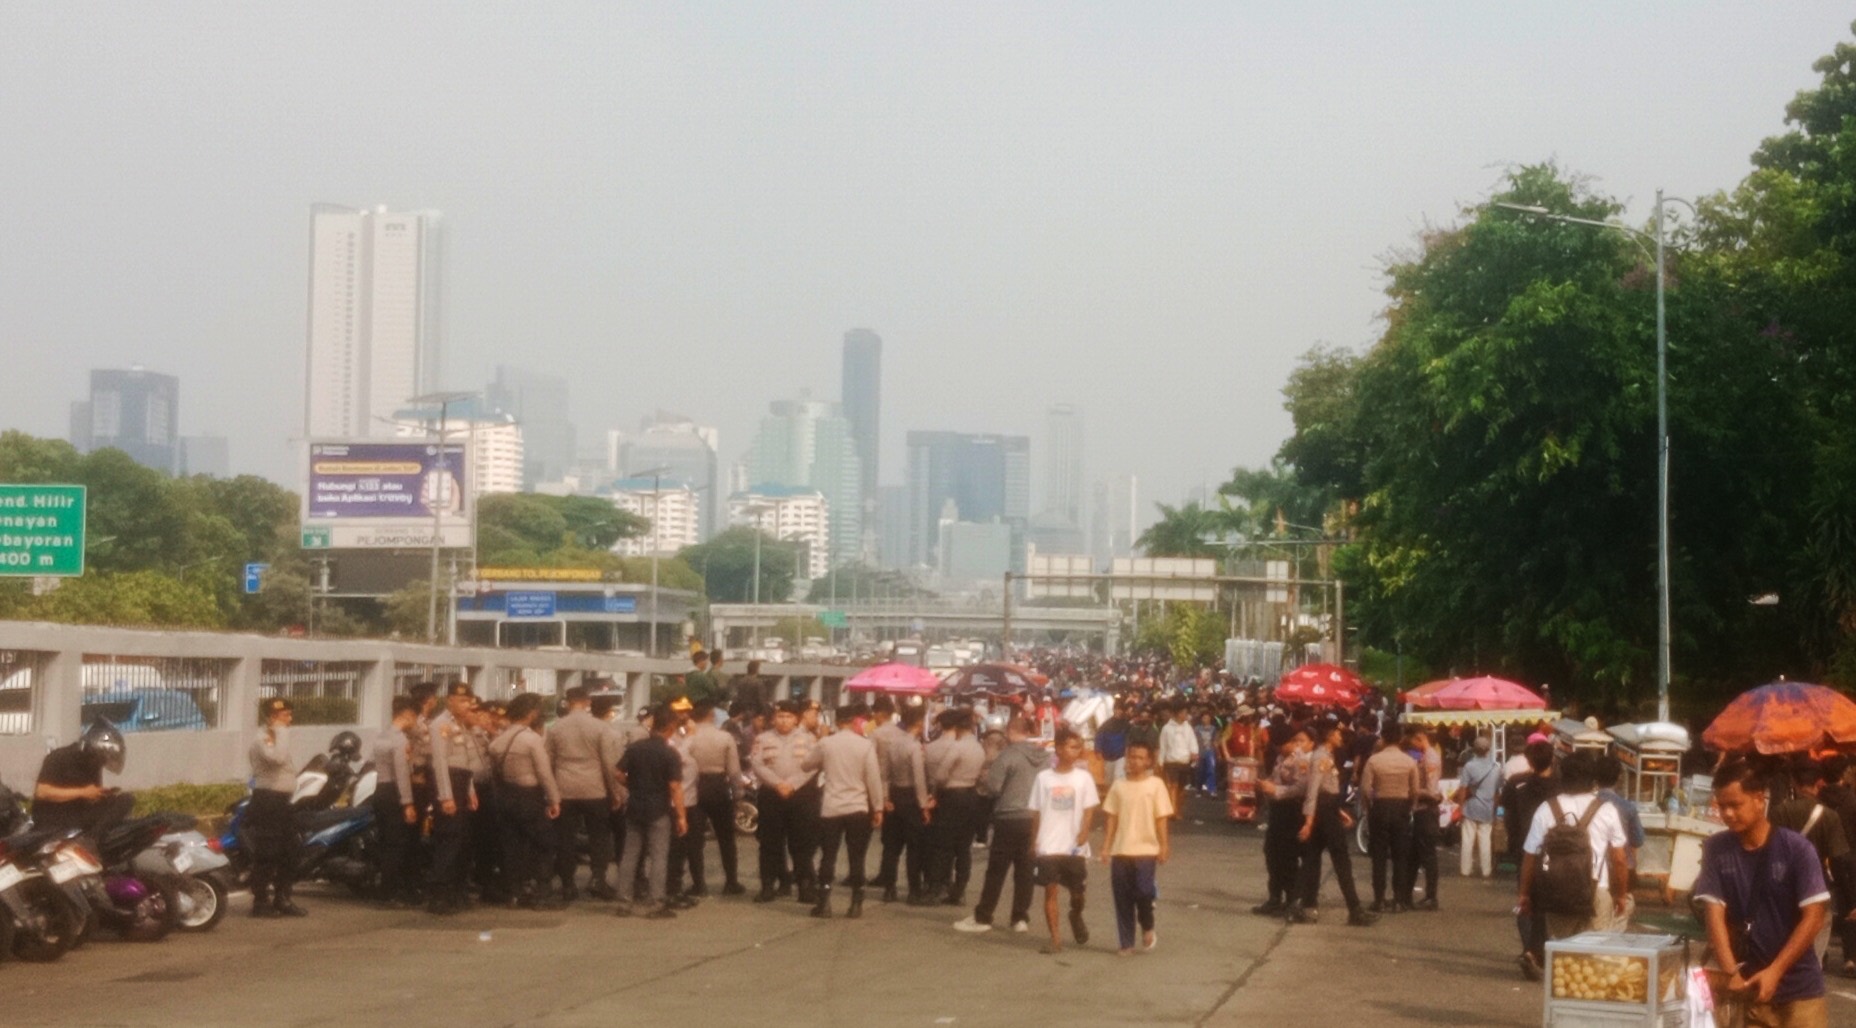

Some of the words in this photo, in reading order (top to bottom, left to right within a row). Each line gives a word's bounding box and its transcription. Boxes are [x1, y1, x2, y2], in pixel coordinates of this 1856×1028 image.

[318, 481, 357, 492] Hubungi
[382, 481, 403, 491] atau
[34, 495, 75, 508] Hilir
[341, 493, 377, 504] Aplikasi
[0, 516, 57, 530] nayan
[0, 534, 74, 549] bayoran
[357, 535, 446, 546] PEJOMPONGAN
[40, 554, 54, 566] m
